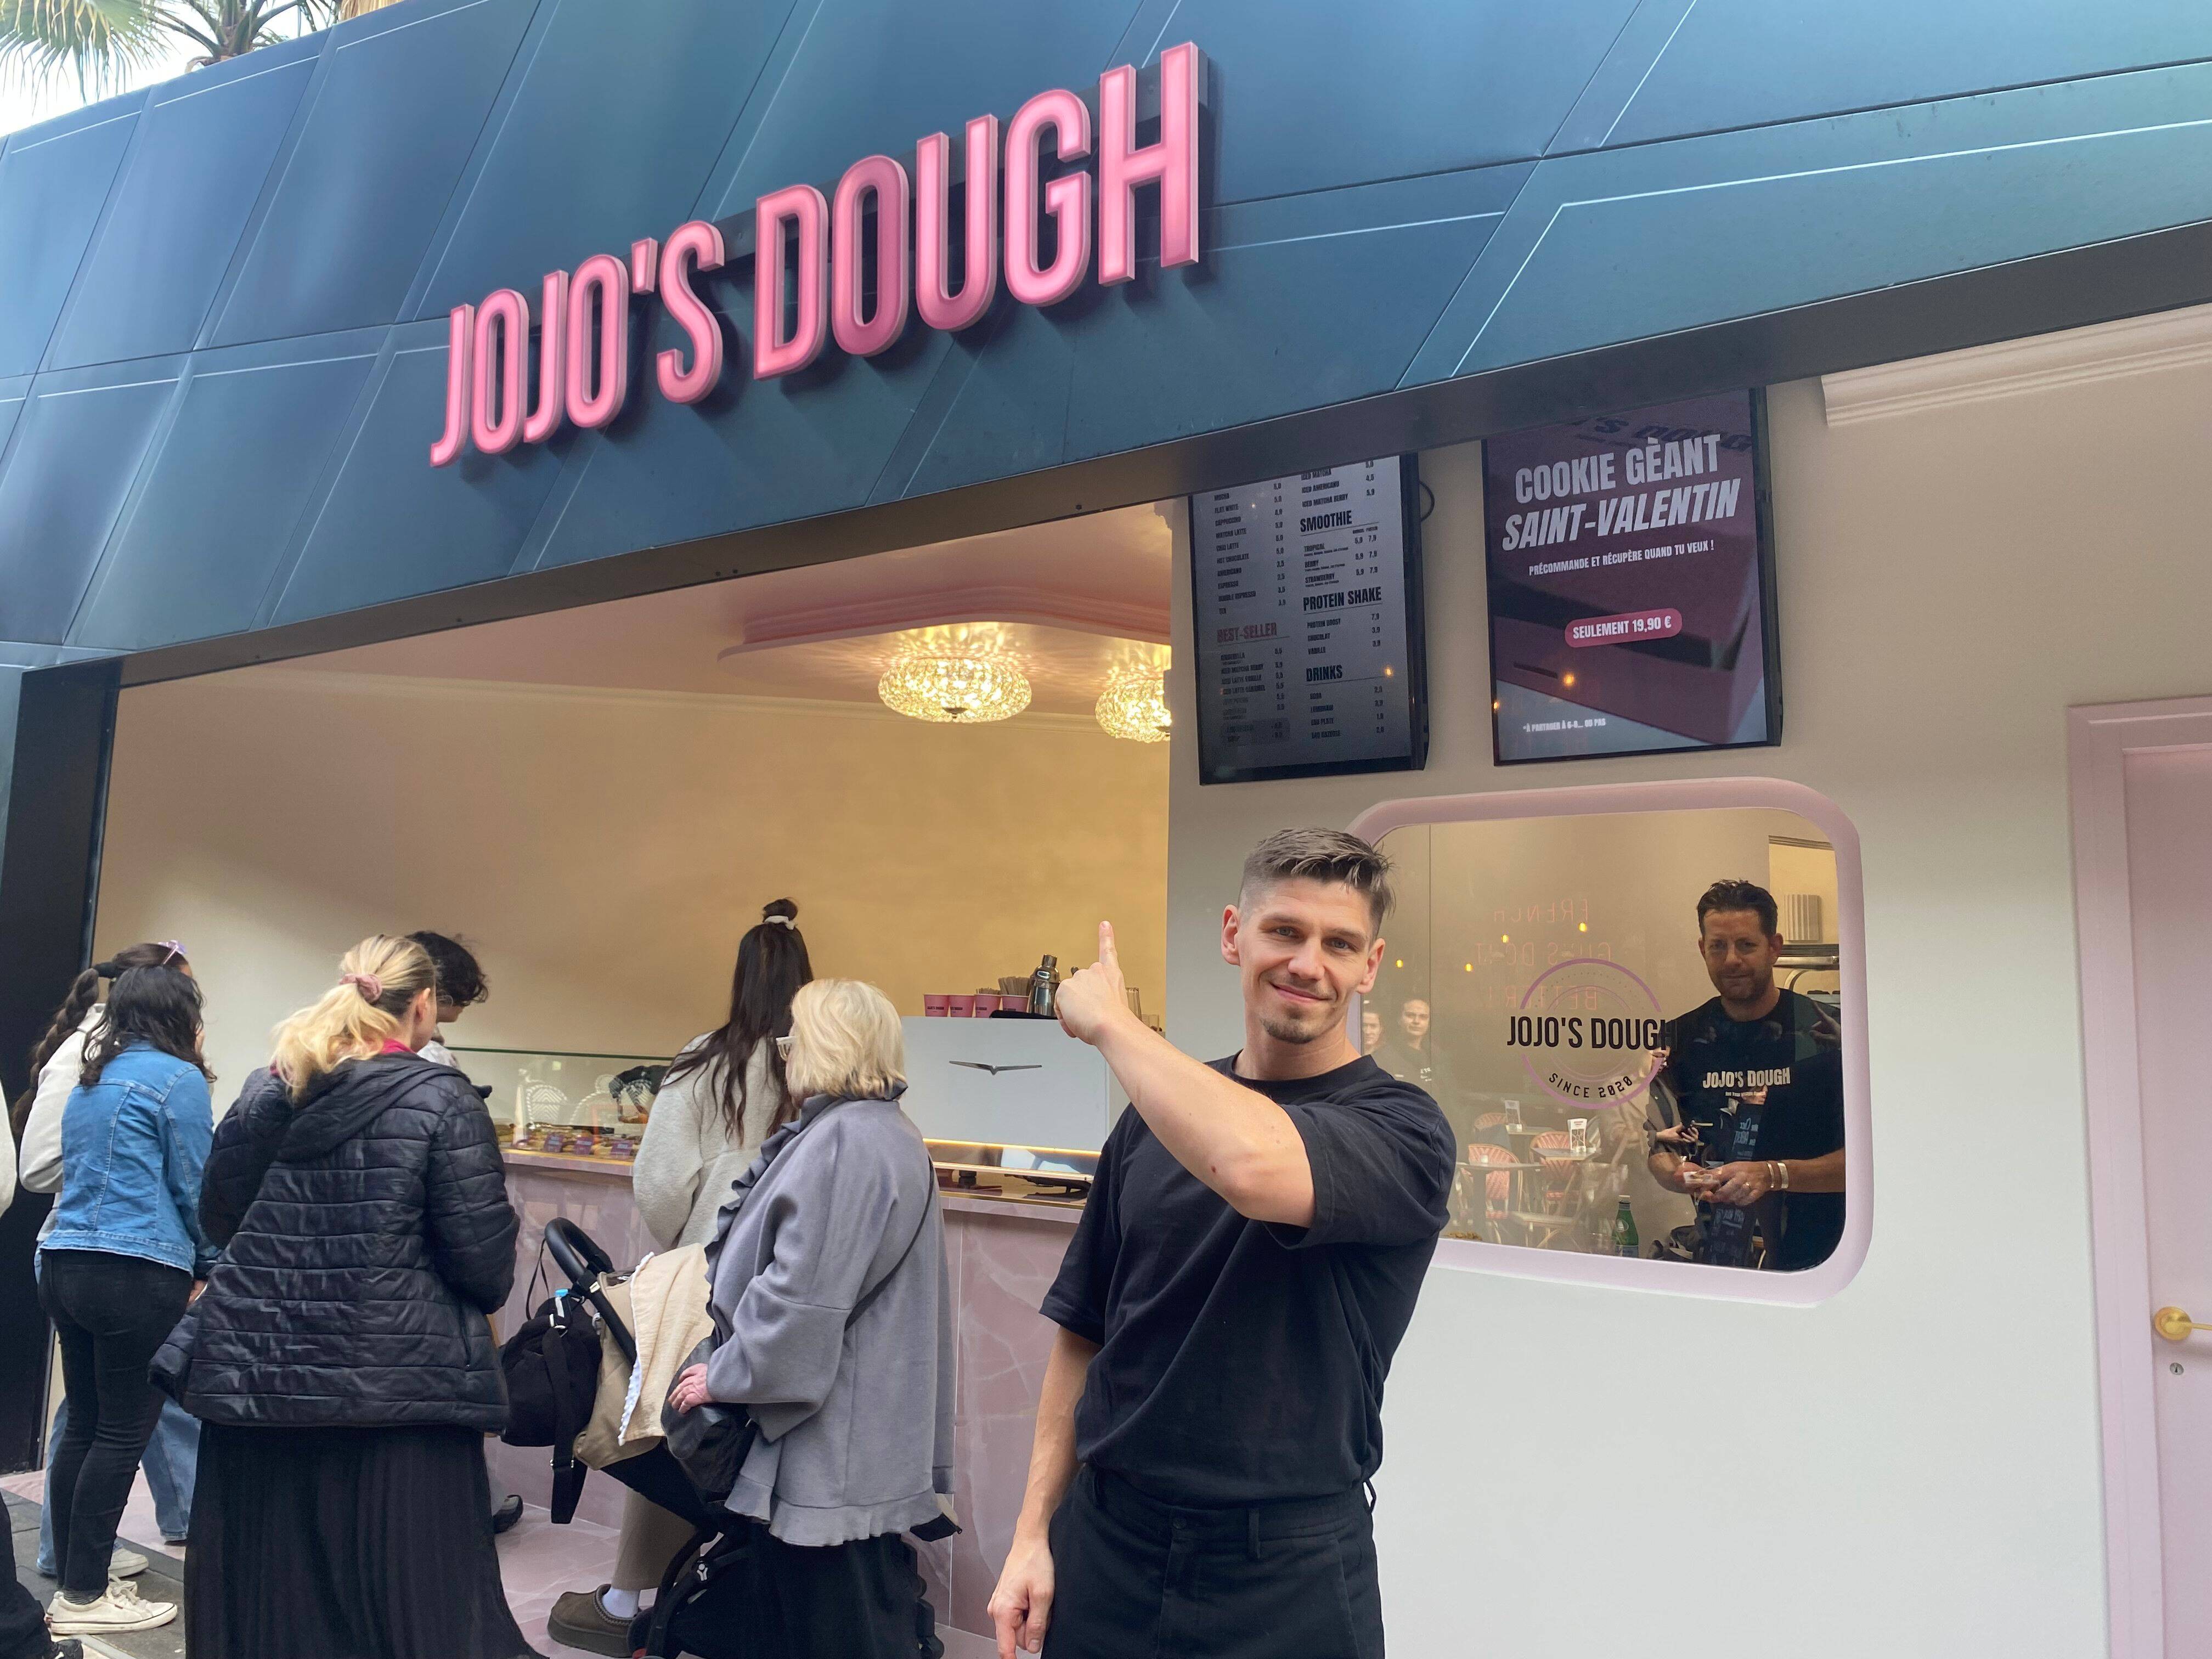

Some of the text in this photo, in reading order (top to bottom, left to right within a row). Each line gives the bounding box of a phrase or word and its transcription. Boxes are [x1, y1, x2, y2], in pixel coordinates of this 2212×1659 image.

[430, 41, 1199, 467] JOJO'S DOUGH
[1515, 452, 1616, 504] COOKIE
[1300, 510, 1352, 532] SMOOTHIE
[1502, 478, 1741, 551] SAINT-VALENTIN
[1529, 539, 1714, 576] PRÉCOMMANDE ET RÉCUPÈRE QUAND TU VEUX !
[1303, 586, 1381, 612] PROTEIN SHAKE
[1217, 622, 1278, 642] BEST-SELLER
[1573, 615, 1672, 639] SEULEMENT 19,90 €
[1306, 664, 1343, 682] DRINKS
[1507, 1016, 1583, 1048] JOJO'S
[1549, 1073, 1633, 1098] SINCE 2020
[1702, 1067, 1791, 1088] JOJO'S DOUGH
